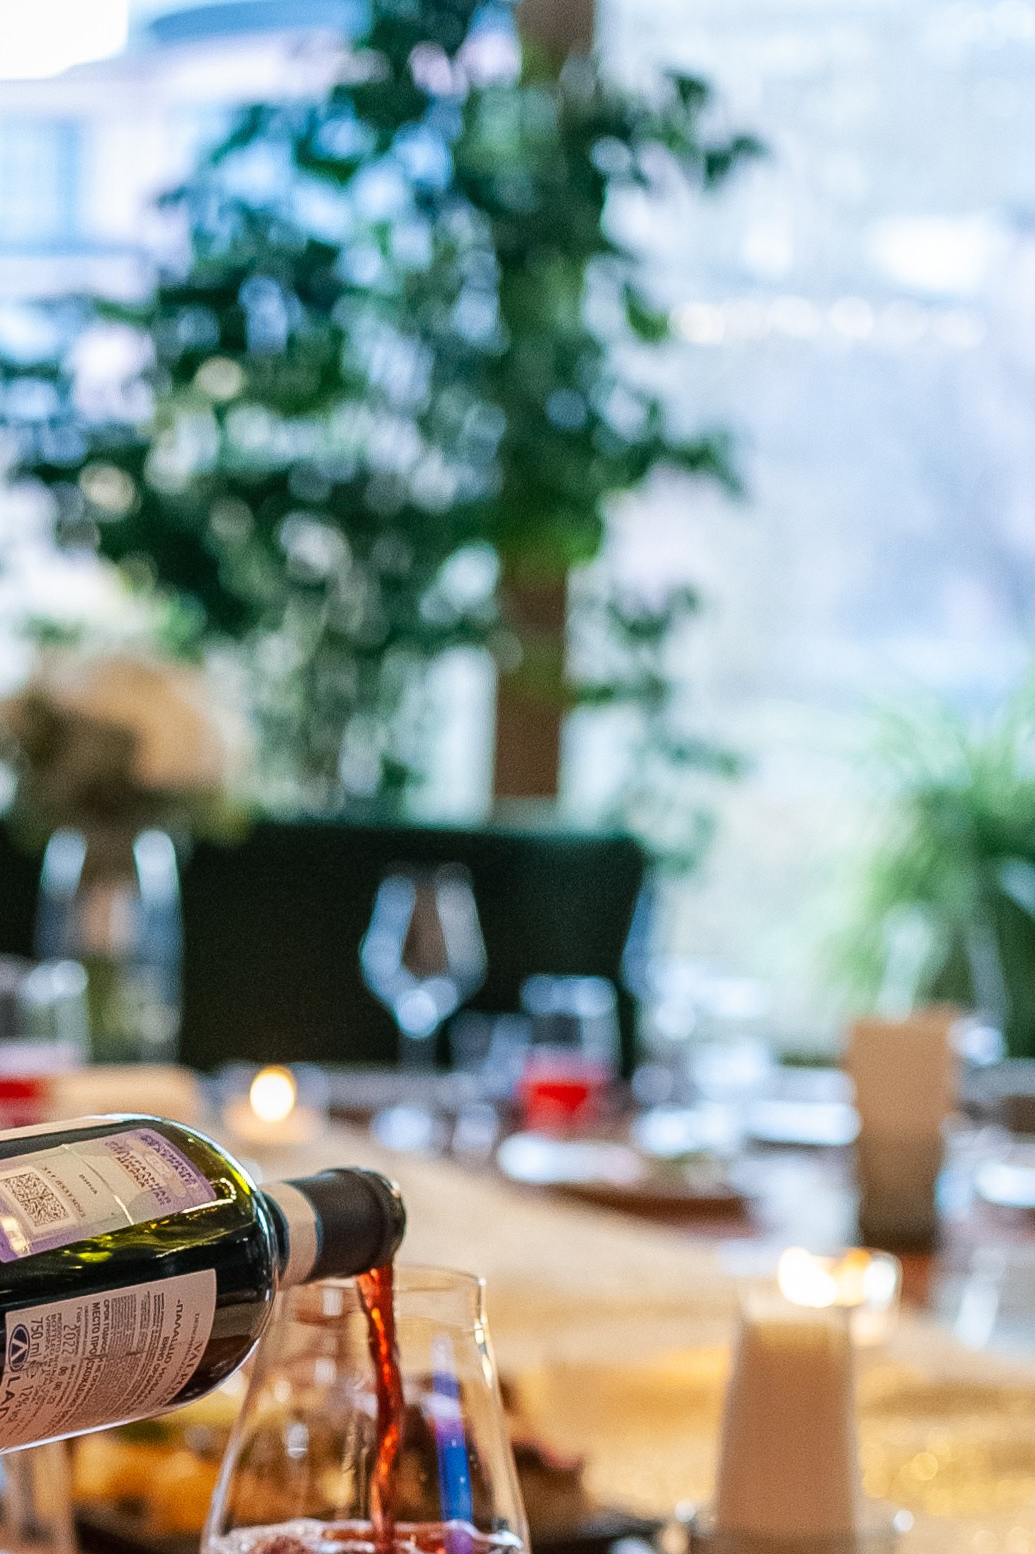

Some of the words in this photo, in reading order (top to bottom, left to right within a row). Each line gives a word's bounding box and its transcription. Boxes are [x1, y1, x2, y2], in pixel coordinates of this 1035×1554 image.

[30, 1317, 42, 1339] 750
[91, 1302, 99, 1333] МЕСТО
[30, 1342, 41, 1357] ml
[61, 1323, 76, 1354] 2022
[97, 1323, 109, 1361] ГОДНОСИ
[69, 1335, 97, 1407] ПРОСХОЖДЕНИЯ
